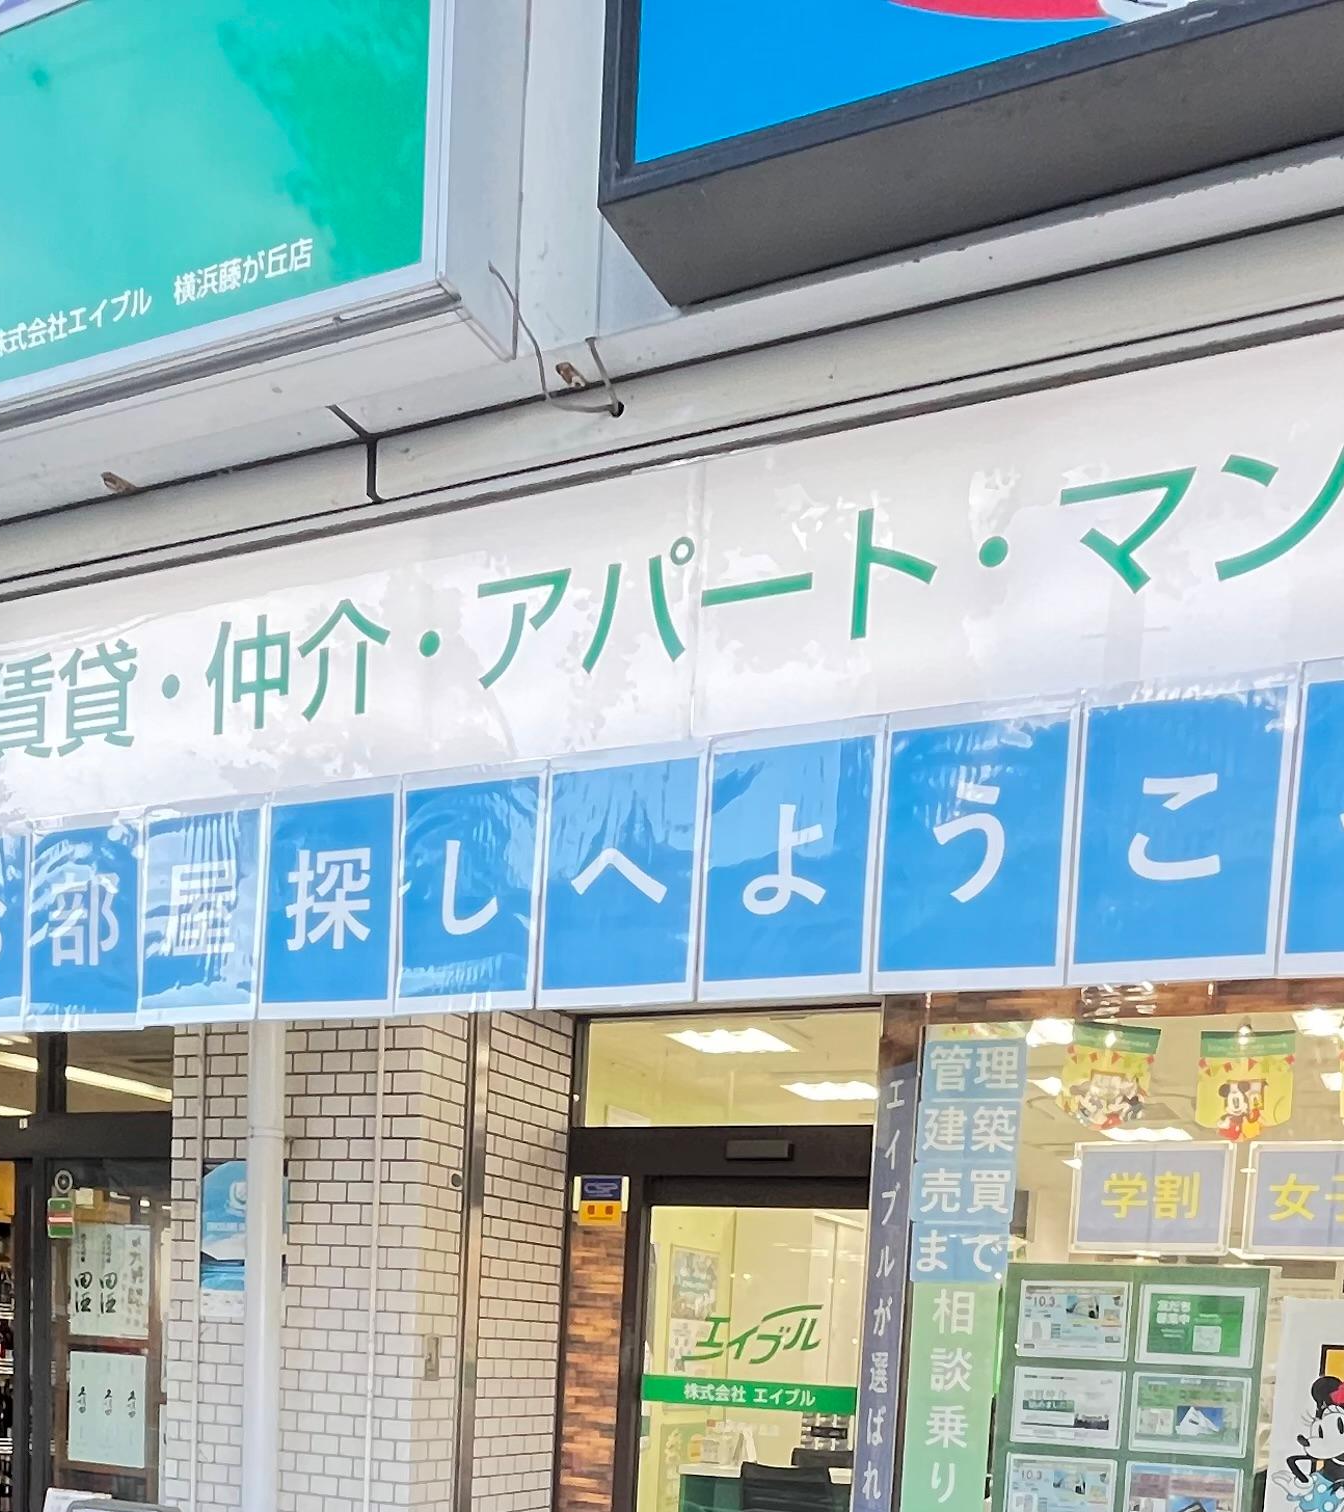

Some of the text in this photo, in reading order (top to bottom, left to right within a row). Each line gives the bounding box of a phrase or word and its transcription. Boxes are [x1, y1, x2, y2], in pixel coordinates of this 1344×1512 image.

[174, 238, 314, 306] 横浜藤が丘店
[930, 1044, 1020, 1093] 管理
[921, 1105, 1017, 1154] 建築
[920, 1167, 1012, 1215] 売買
[1102, 1172, 1201, 1220] 学割
[915, 1228, 1003, 1277] まで
[682, 1303, 824, 1364] エイブル
[684, 1382, 817, 1408] 株式会社 エイブル
